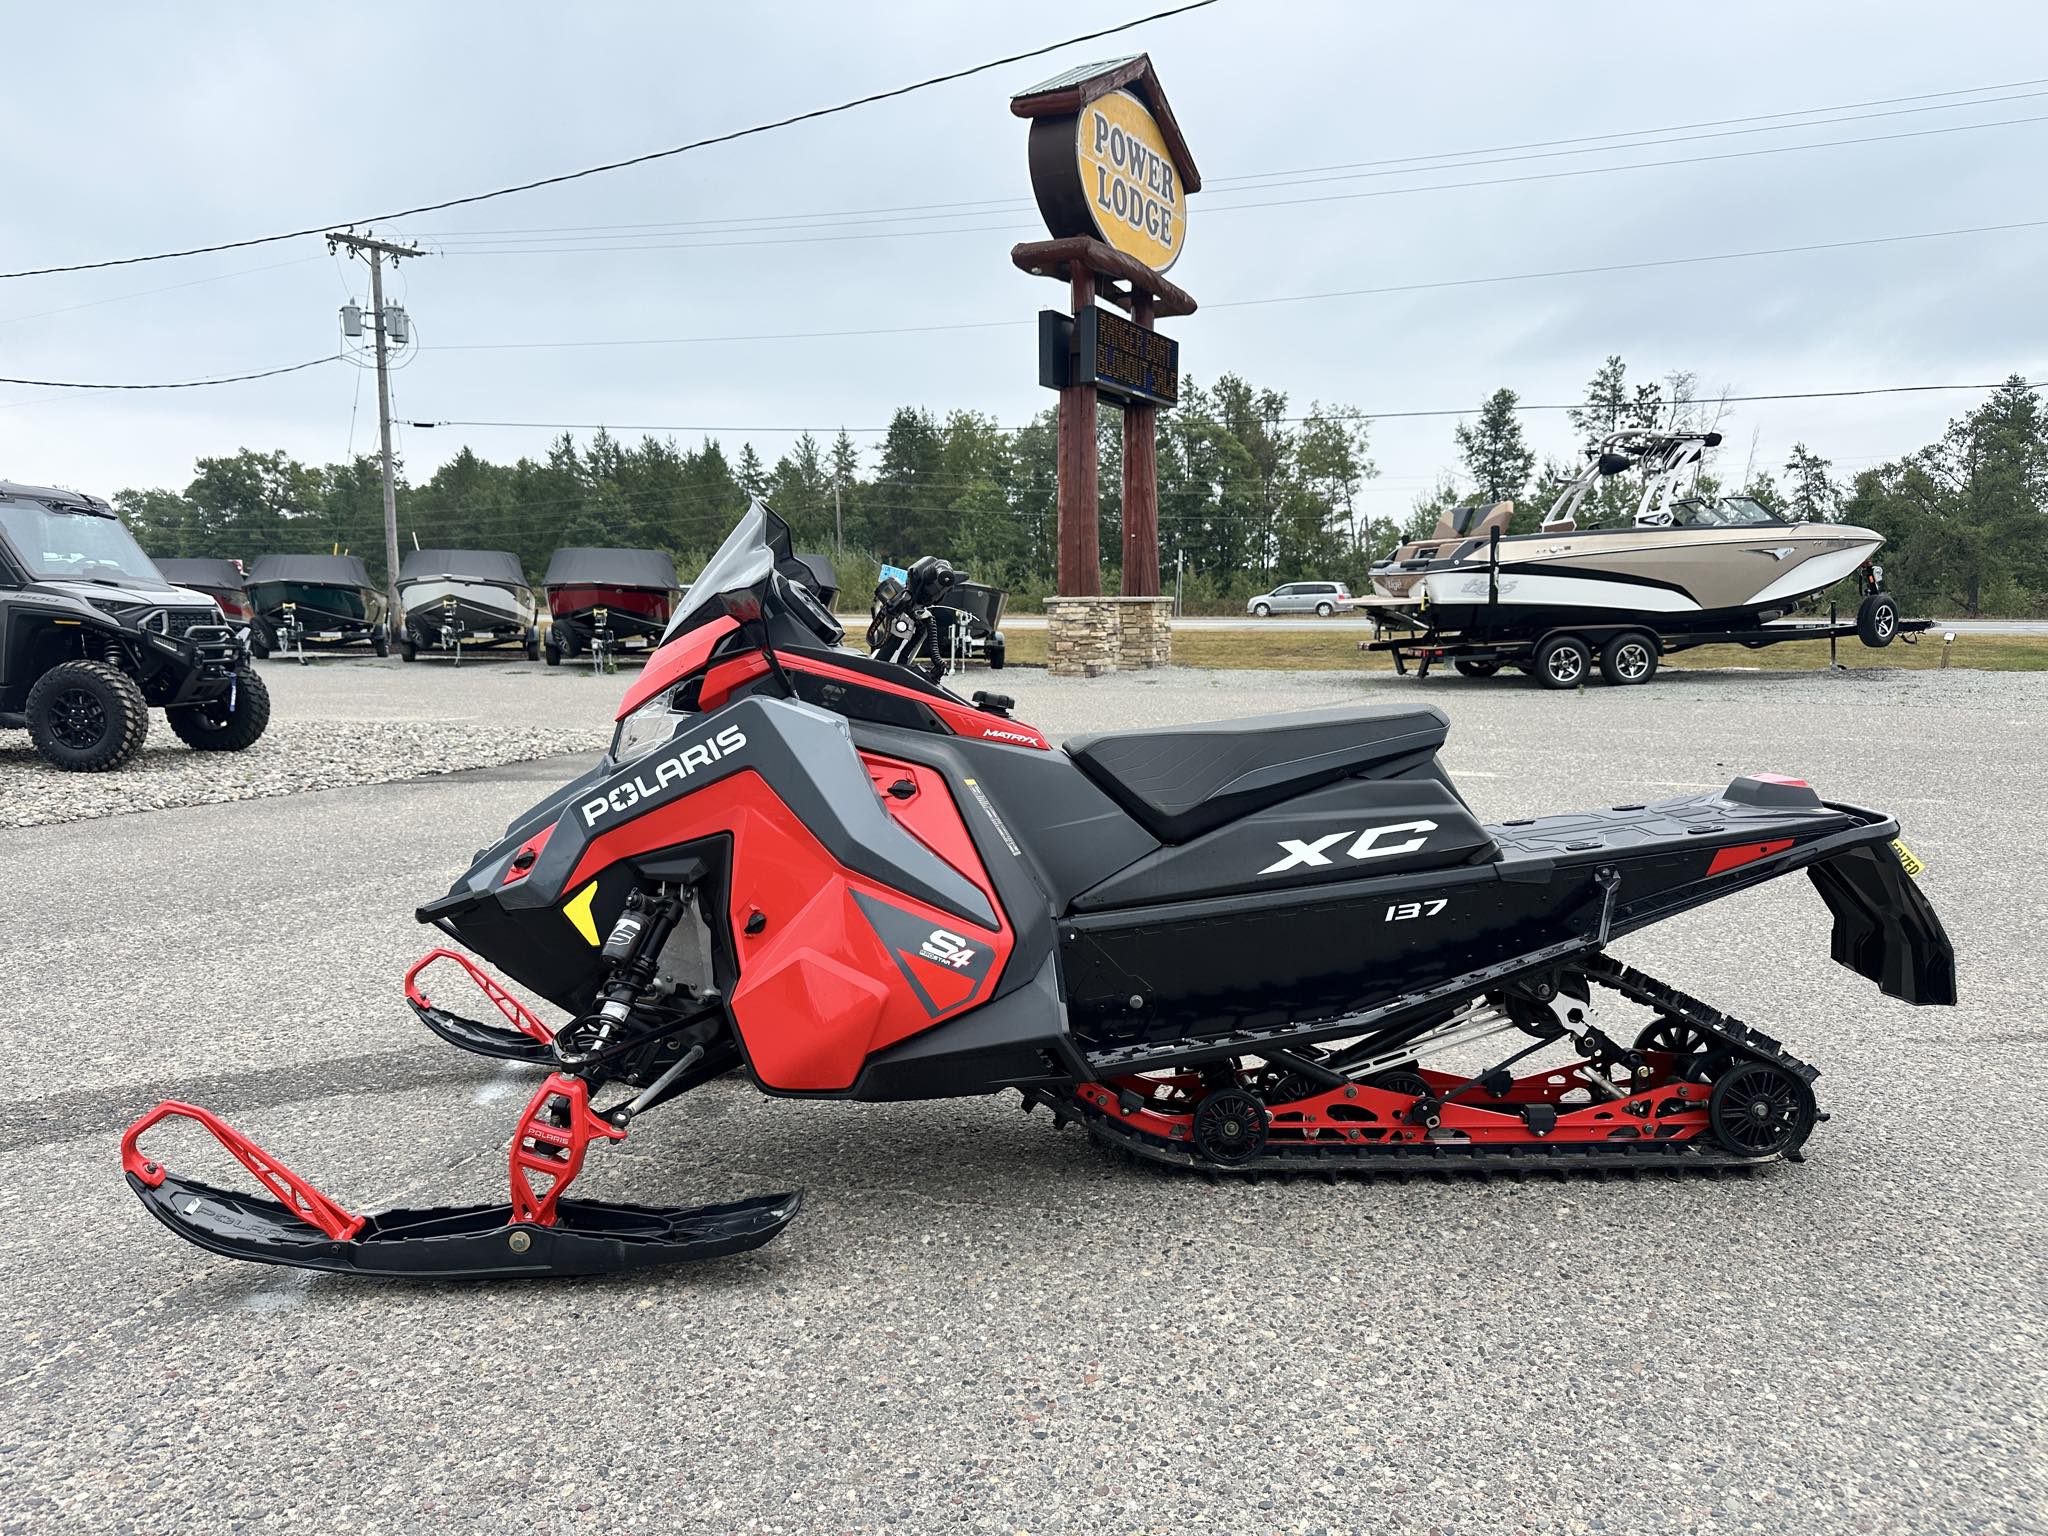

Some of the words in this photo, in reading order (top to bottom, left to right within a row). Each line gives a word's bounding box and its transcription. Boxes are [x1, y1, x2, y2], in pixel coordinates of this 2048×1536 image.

[1094, 111, 1175, 204] POWER
[1097, 165, 1173, 246] LODGE
[1098, 313, 1143, 357] RANGER
[1096, 343, 1148, 389] BLOWOUT
[1150, 363, 1177, 399] SALE
[983, 728, 1039, 747] MATRYX
[581, 724, 747, 828] POLARIS
[1256, 819, 1439, 875] XC
[1384, 898, 1449, 922] 137
[527, 1127, 569, 1145] POLARIS
[196, 1206, 297, 1241] POLARI
